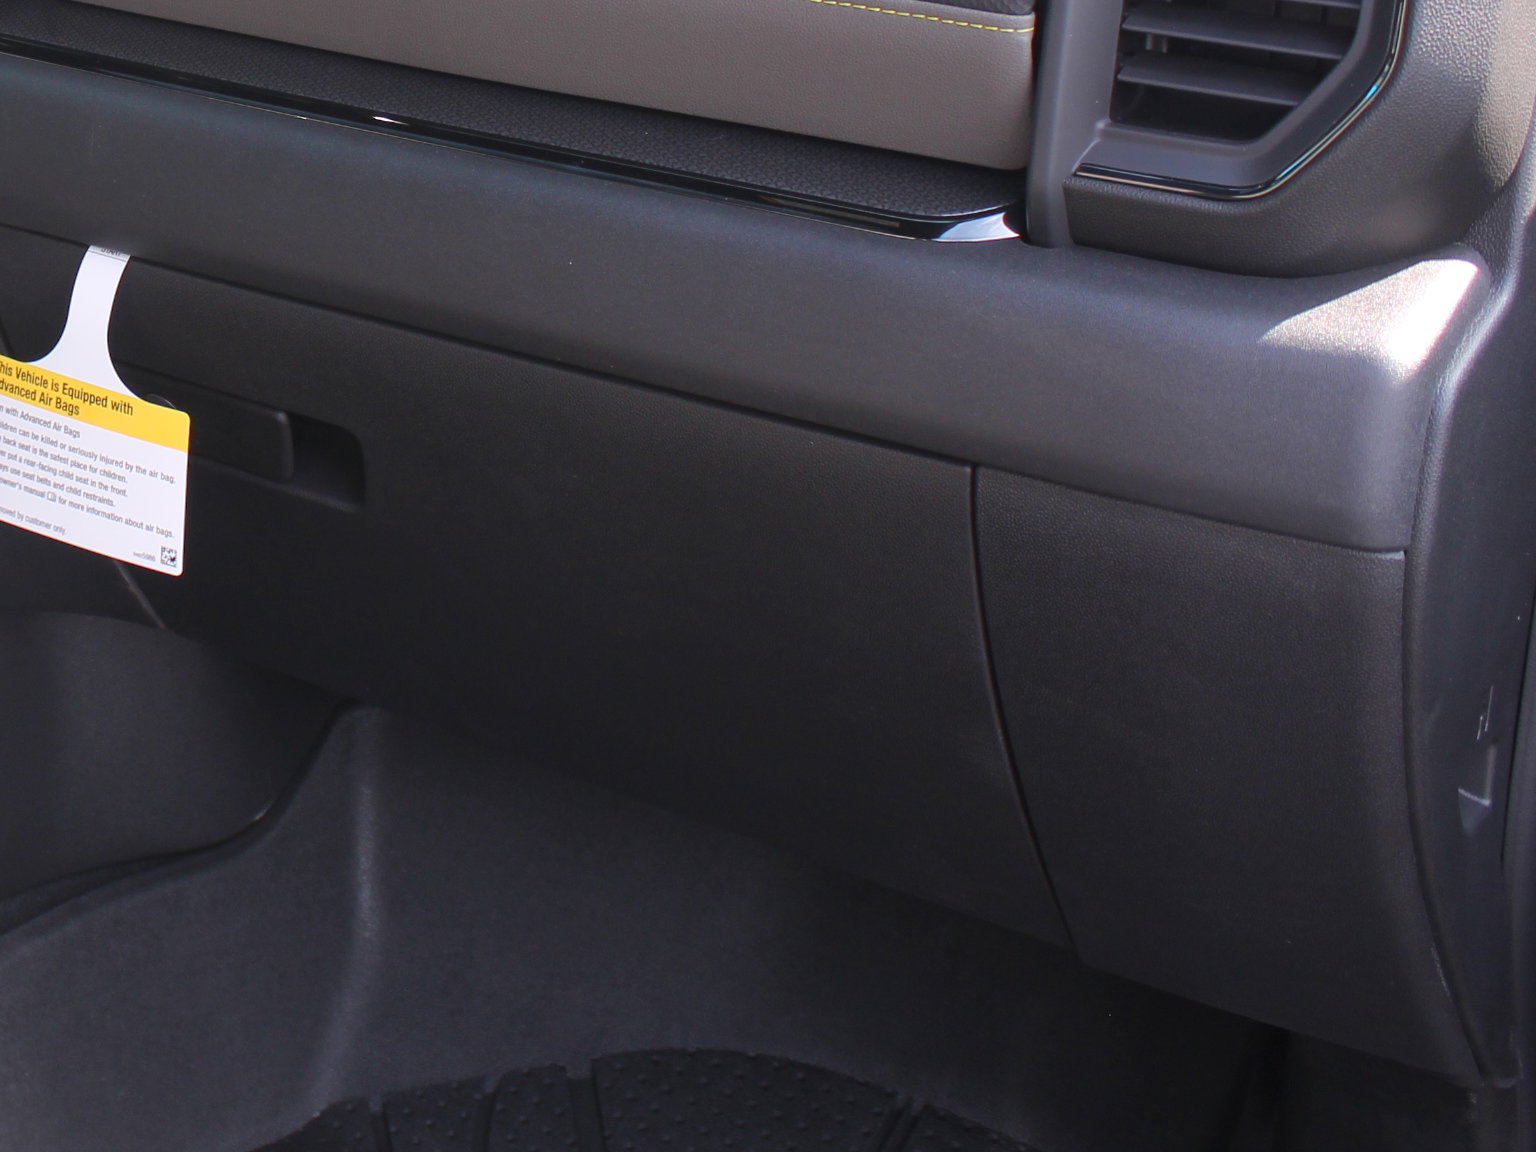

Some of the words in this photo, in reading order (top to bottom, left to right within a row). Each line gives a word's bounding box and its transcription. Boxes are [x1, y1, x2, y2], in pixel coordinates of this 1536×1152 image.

[15, 367, 48, 388] Vehicle
[51, 378, 59, 392] is
[62, 383, 108, 408] Equipped
[111, 400, 133, 416] with
[39, 392, 53, 406] Air
[56, 397, 79, 416] Bags
[5, 407, 18, 416] with
[20, 411, 51, 428] Advanced
[53, 422, 62, 431] Air
[64, 425, 80, 438] Bags
[3, 436, 16, 446] back
[18, 442, 31, 452] seat
[39, 448, 48, 458] the
[50, 452, 69, 464] safest
[70, 460, 87, 471] place
[89, 465, 98, 473] for
[7, 452, 17, 461] put
[58, 469, 74, 480] child
[76, 475, 89, 485] seat
[99, 482, 108, 491] the
[19, 428, 30, 437] can
[31, 432, 39, 441] be
[41, 435, 58, 447] killed
[68, 445, 98, 462] seriously
[100, 454, 123, 468] injured
[125, 462, 133, 472] by
[136, 466, 146, 475] the
[149, 470, 158, 478] air
[10, 468, 20, 476] use
[22, 471, 35, 481] seat
[37, 475, 51, 486] belts
[53, 482, 64, 490] and
[66, 485, 81, 496] child
[23, 486, 45, 498] manual
[68, 501, 84, 511] more
[86, 505, 123, 523] information
[125, 518, 144, 529] about
[146, 524, 154, 532] air
